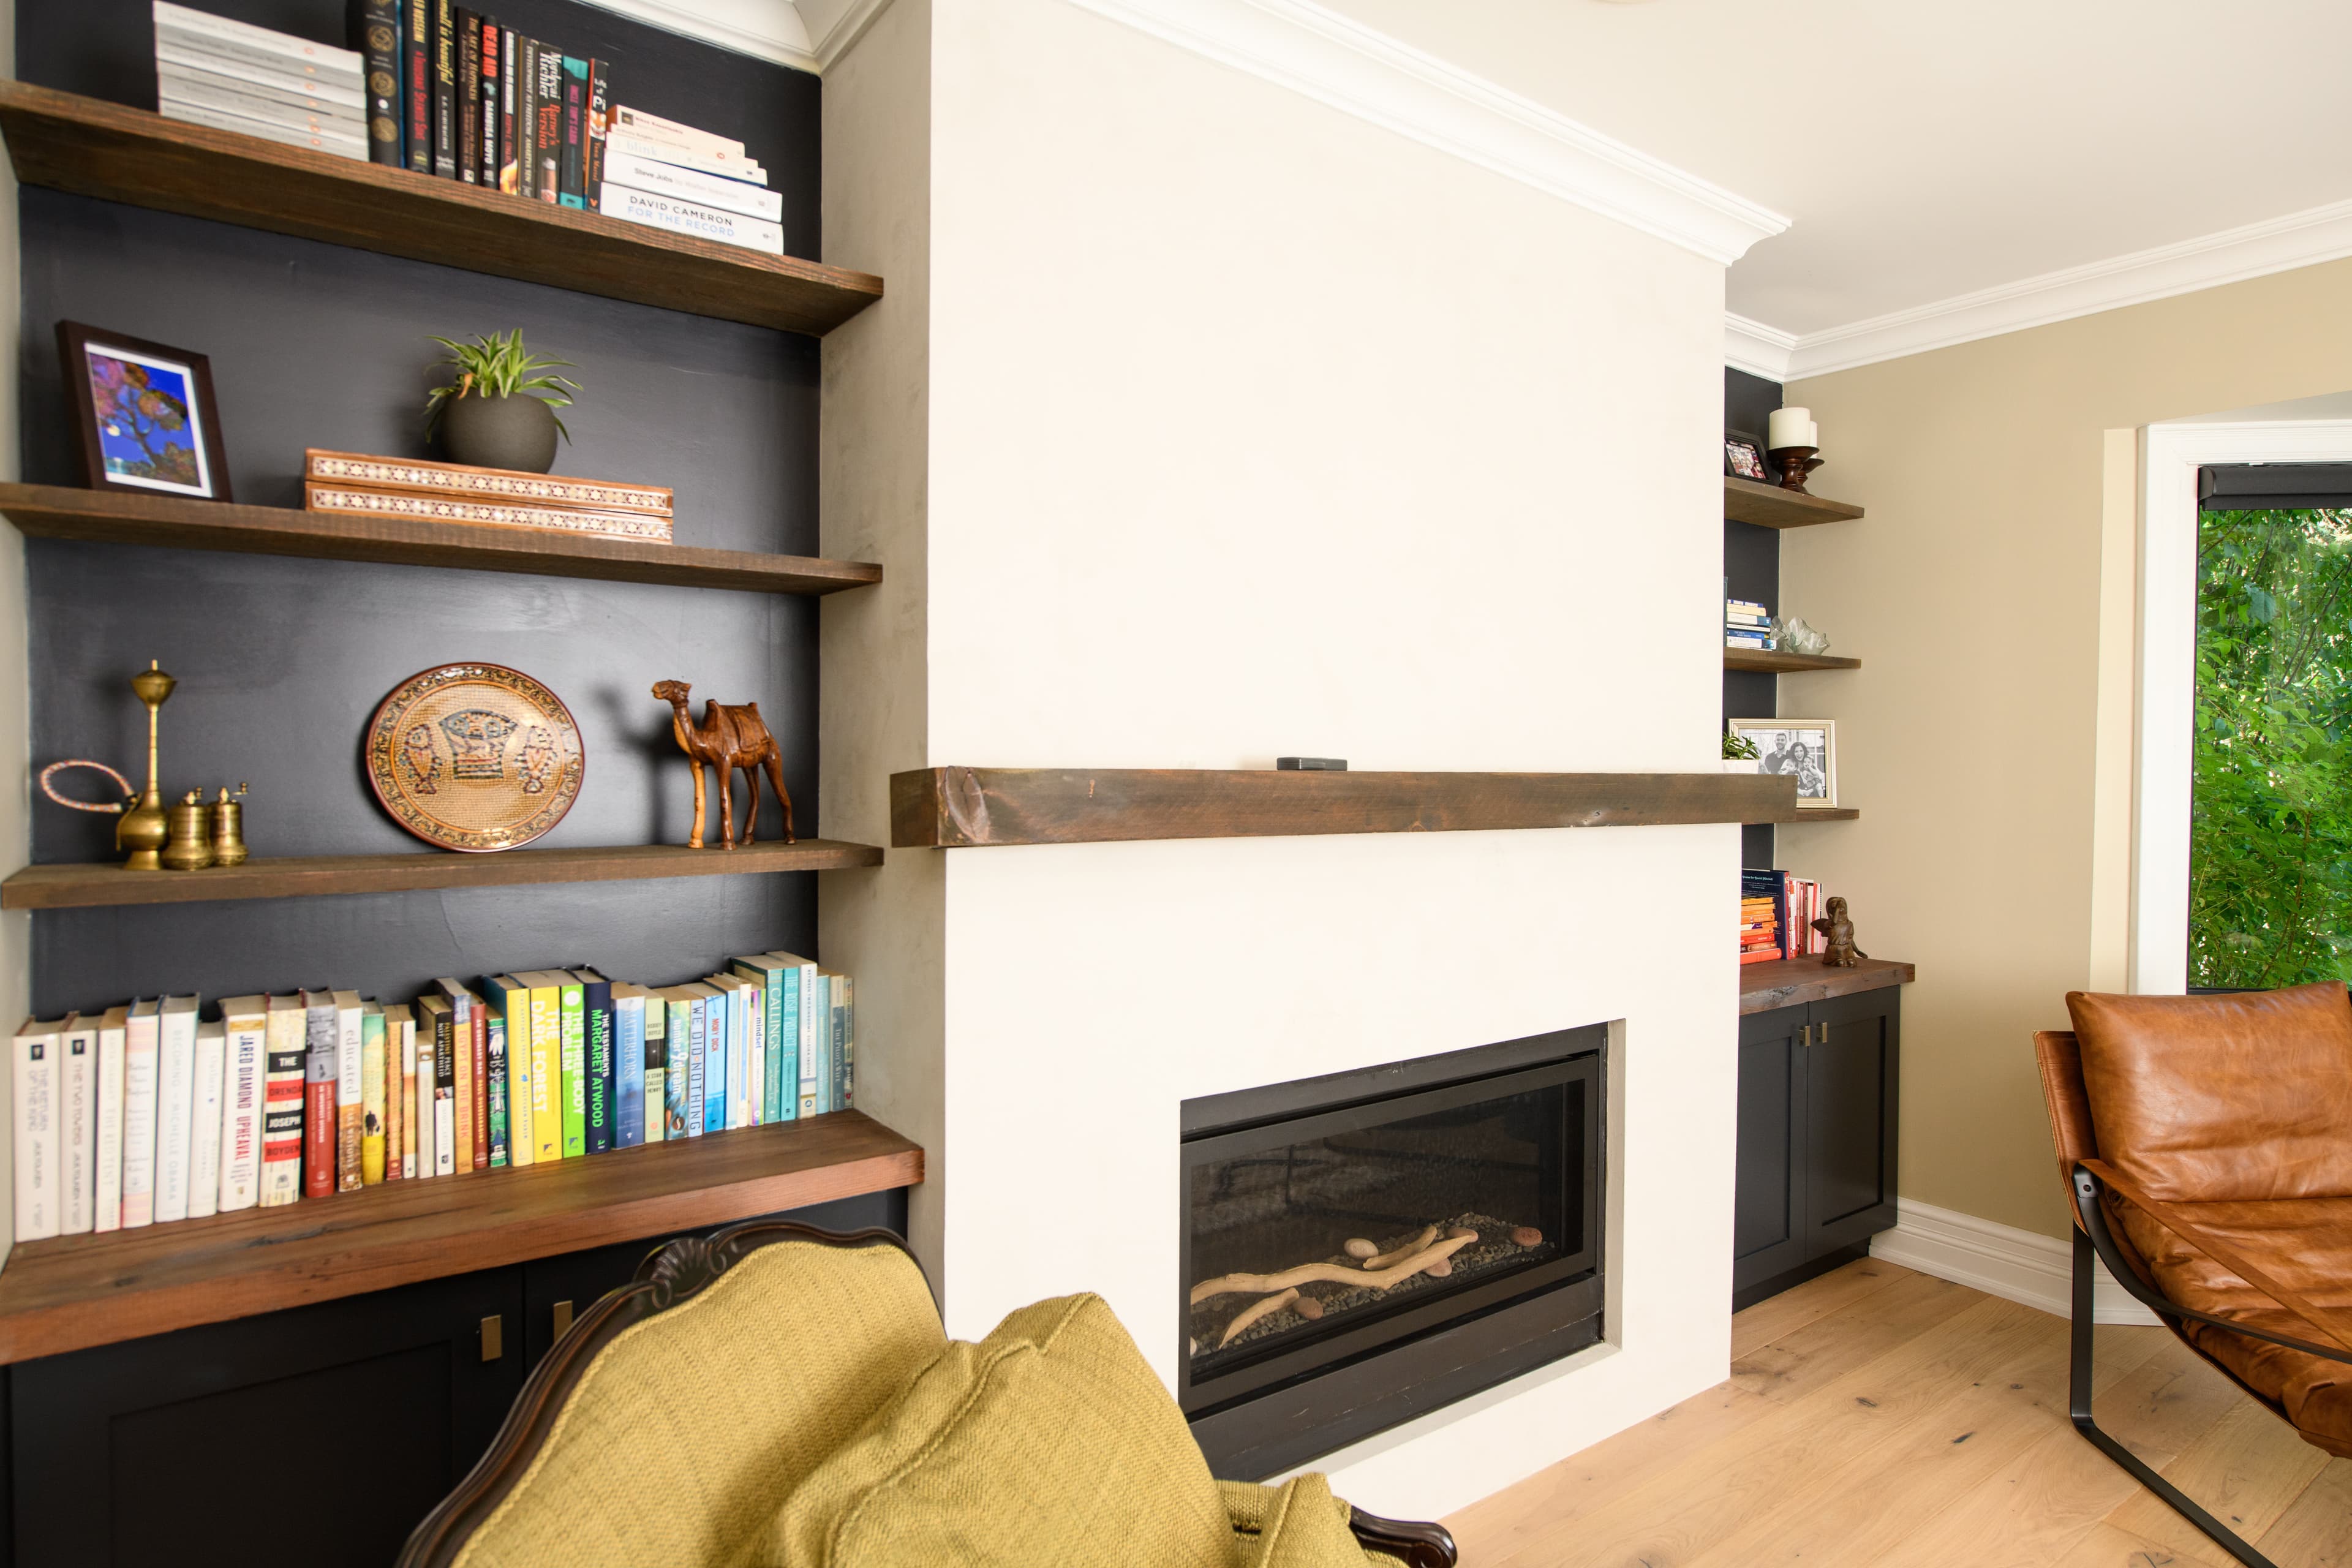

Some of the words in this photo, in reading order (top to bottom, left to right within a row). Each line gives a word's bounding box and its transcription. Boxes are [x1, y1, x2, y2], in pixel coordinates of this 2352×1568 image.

[483, 25, 497, 56] DEAD
[435, 37, 453, 86] beautiful
[483, 56, 497, 77] AID
[539, 52, 552, 99] Richler
[549, 51, 562, 100] Mordecai
[592, 95, 606, 111] Pi
[538, 107, 553, 149] Version
[549, 104, 561, 146] Barney's
[484, 139, 494, 165] MOYO
[627, 140, 657, 156] blink
[633, 167, 655, 179] Steve
[655, 173, 674, 184] Jobs
[627, 205, 653, 219] FOR
[658, 212, 681, 225] THE
[685, 219, 735, 237] RECORD
[629, 195, 668, 211] DAVID
[673, 205, 733, 226] CAMERON
[785, 974, 797, 990] THE
[692, 1006, 704, 1025] WE
[769, 987, 782, 1050] CALLINGS
[784, 992, 797, 1014] ROSIE
[532, 1000, 546, 1045] DARK
[546, 1007, 560, 1039] THE
[573, 1011, 584, 1035] THE
[711, 1017, 720, 1036] MOBY
[783, 1016, 797, 1047] PROJECT
[239, 1035, 254, 1065] JARED
[458, 1030, 469, 1061] EGYPT
[562, 1012, 573, 1071] PROBLEM
[591, 1009, 603, 1074] MARGARET
[624, 1008, 638, 1080] MATTERHORN
[691, 1031, 703, 1056] DID
[710, 1037, 720, 1053] DICK
[172, 1029, 183, 1087] BECOMING
[279, 1056, 298, 1068] THE
[345, 1030, 358, 1094] educated
[459, 1066, 469, 1079] ON
[237, 1067, 254, 1109] DIAMOND
[459, 1082, 469, 1102] THE
[533, 1050, 548, 1112] FOREST
[572, 1037, 584, 1115] THREE-BODY
[591, 1077, 604, 1128] ATWOOD
[690, 1062, 703, 1130] NOTHING
[168, 1103, 182, 1156] MICHELLE
[268, 1114, 301, 1129] JOSEPH
[459, 1106, 470, 1139] BRINK
[235, 1115, 251, 1161] UPHEAVAL
[266, 1144, 300, 1157] BOYDEN
[167, 1161, 179, 1201] OBAMA
